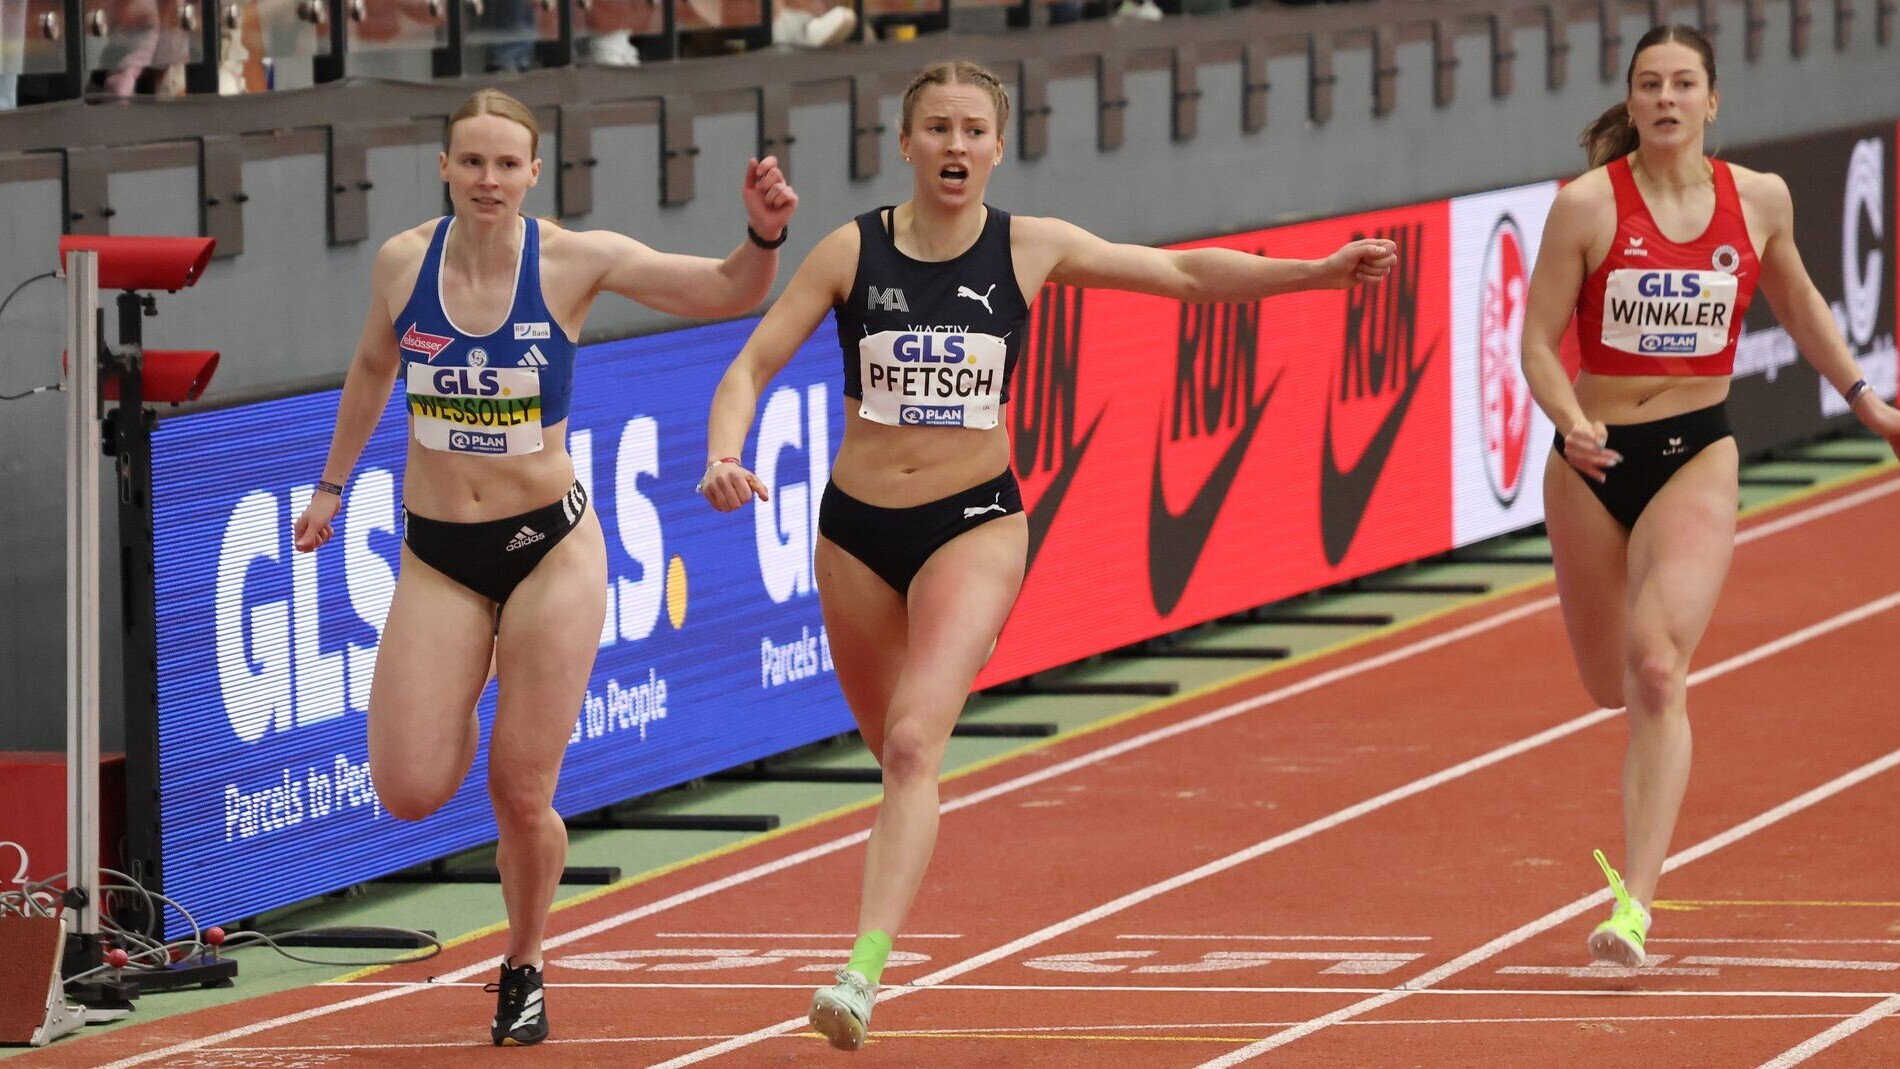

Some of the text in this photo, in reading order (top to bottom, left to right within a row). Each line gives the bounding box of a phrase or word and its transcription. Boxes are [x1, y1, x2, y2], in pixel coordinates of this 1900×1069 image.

[1341, 222, 1424, 405] RUN
[1611, 297, 1727, 326] WINKLER
[403, 335, 443, 351] elsässer
[532, 329, 549, 337] Bank
[1663, 335, 1695, 346] PLAN
[870, 362, 994, 398] PFETSCH
[1013, 283, 1083, 481] UN
[412, 394, 533, 427] WESSOLLY
[926, 409, 961, 420] PLAN
[471, 435, 504, 447] PLAN
[505, 531, 546, 552] adidas
[761, 625, 818, 689] Parcels
[585, 689, 604, 739] to
[607, 667, 667, 742] People
[225, 768, 303, 842] Parcels
[308, 766, 331, 818] to
